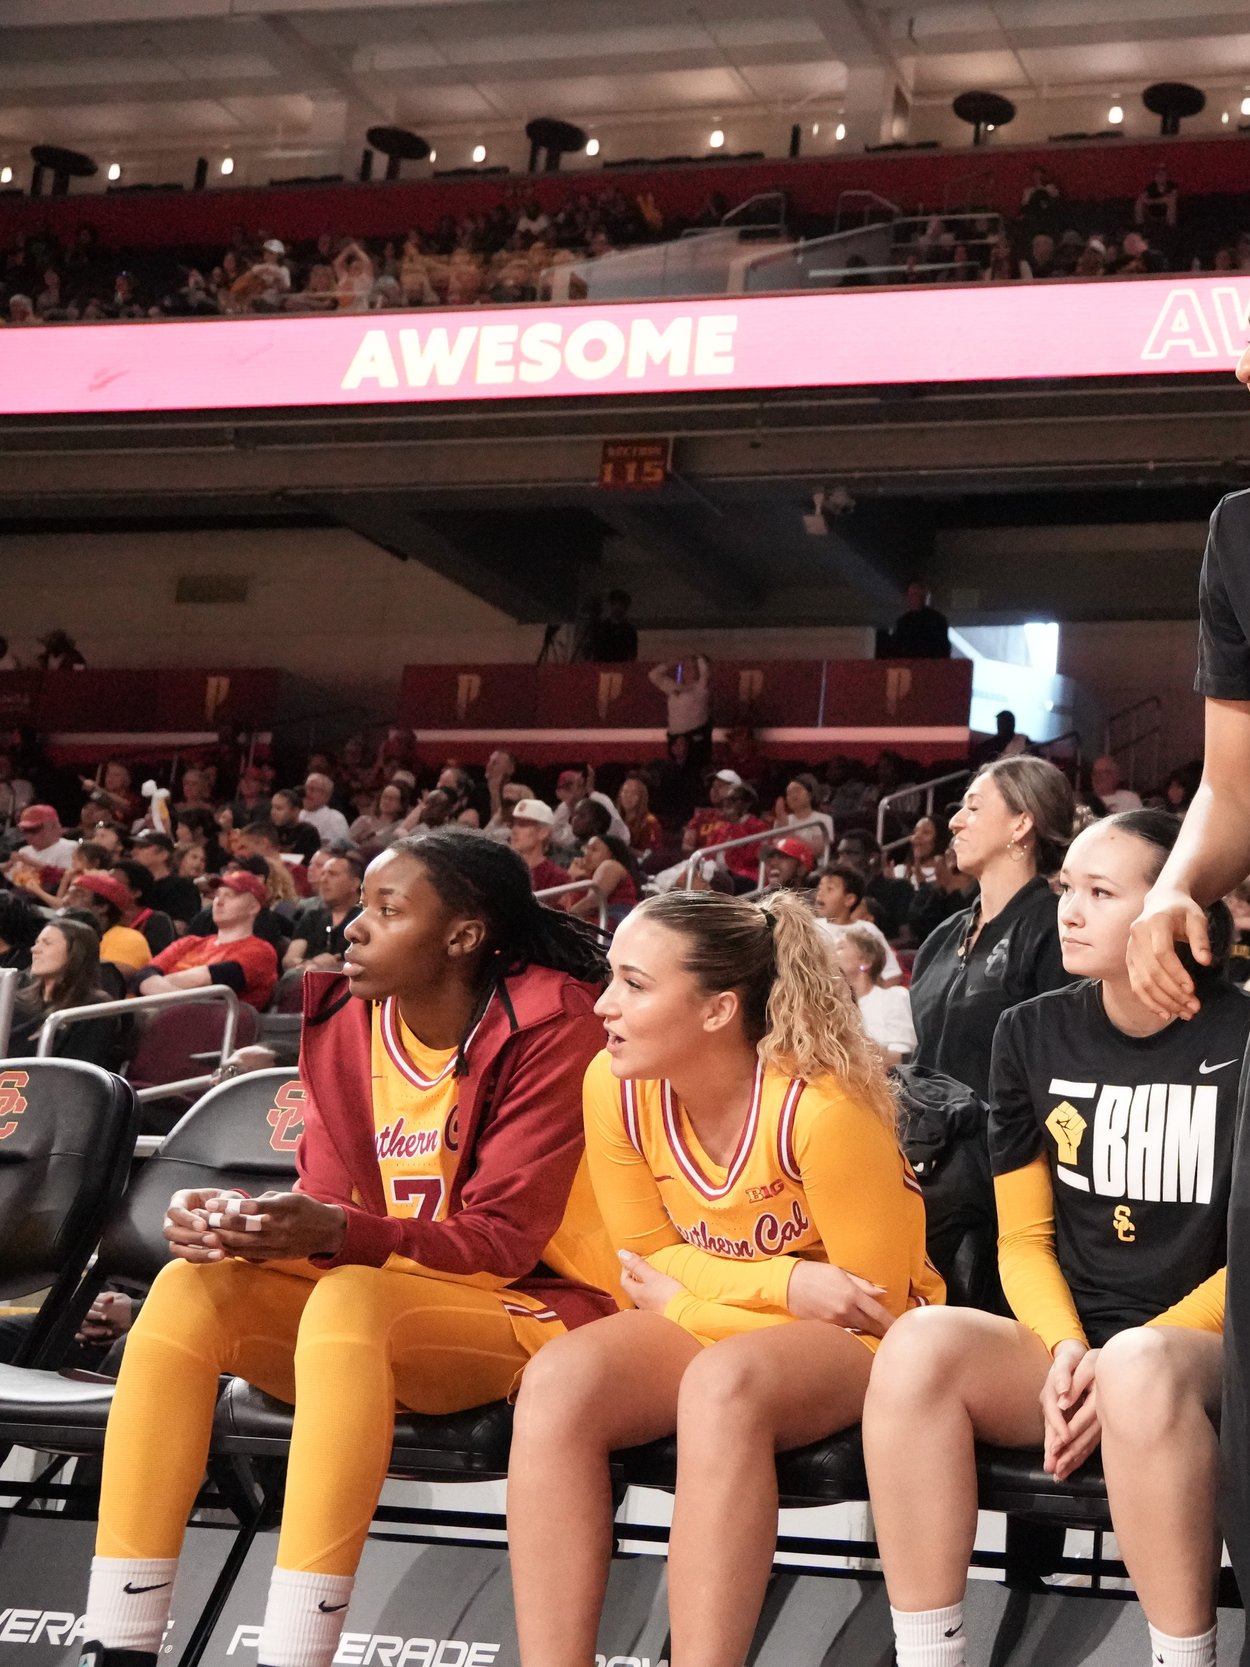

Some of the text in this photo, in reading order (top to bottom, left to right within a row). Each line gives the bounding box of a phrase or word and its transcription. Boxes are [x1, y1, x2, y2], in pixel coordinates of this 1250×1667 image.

[340, 314, 738, 390] AWESOME
[602, 462, 664, 482] 115
[375, 1116, 441, 1160] thern
[1092, 1083, 1218, 1205] BHM
[754, 1199, 809, 1257] Cal
[1112, 1204, 1136, 1242] SC
[226, 1624, 501, 1667] PERADE
